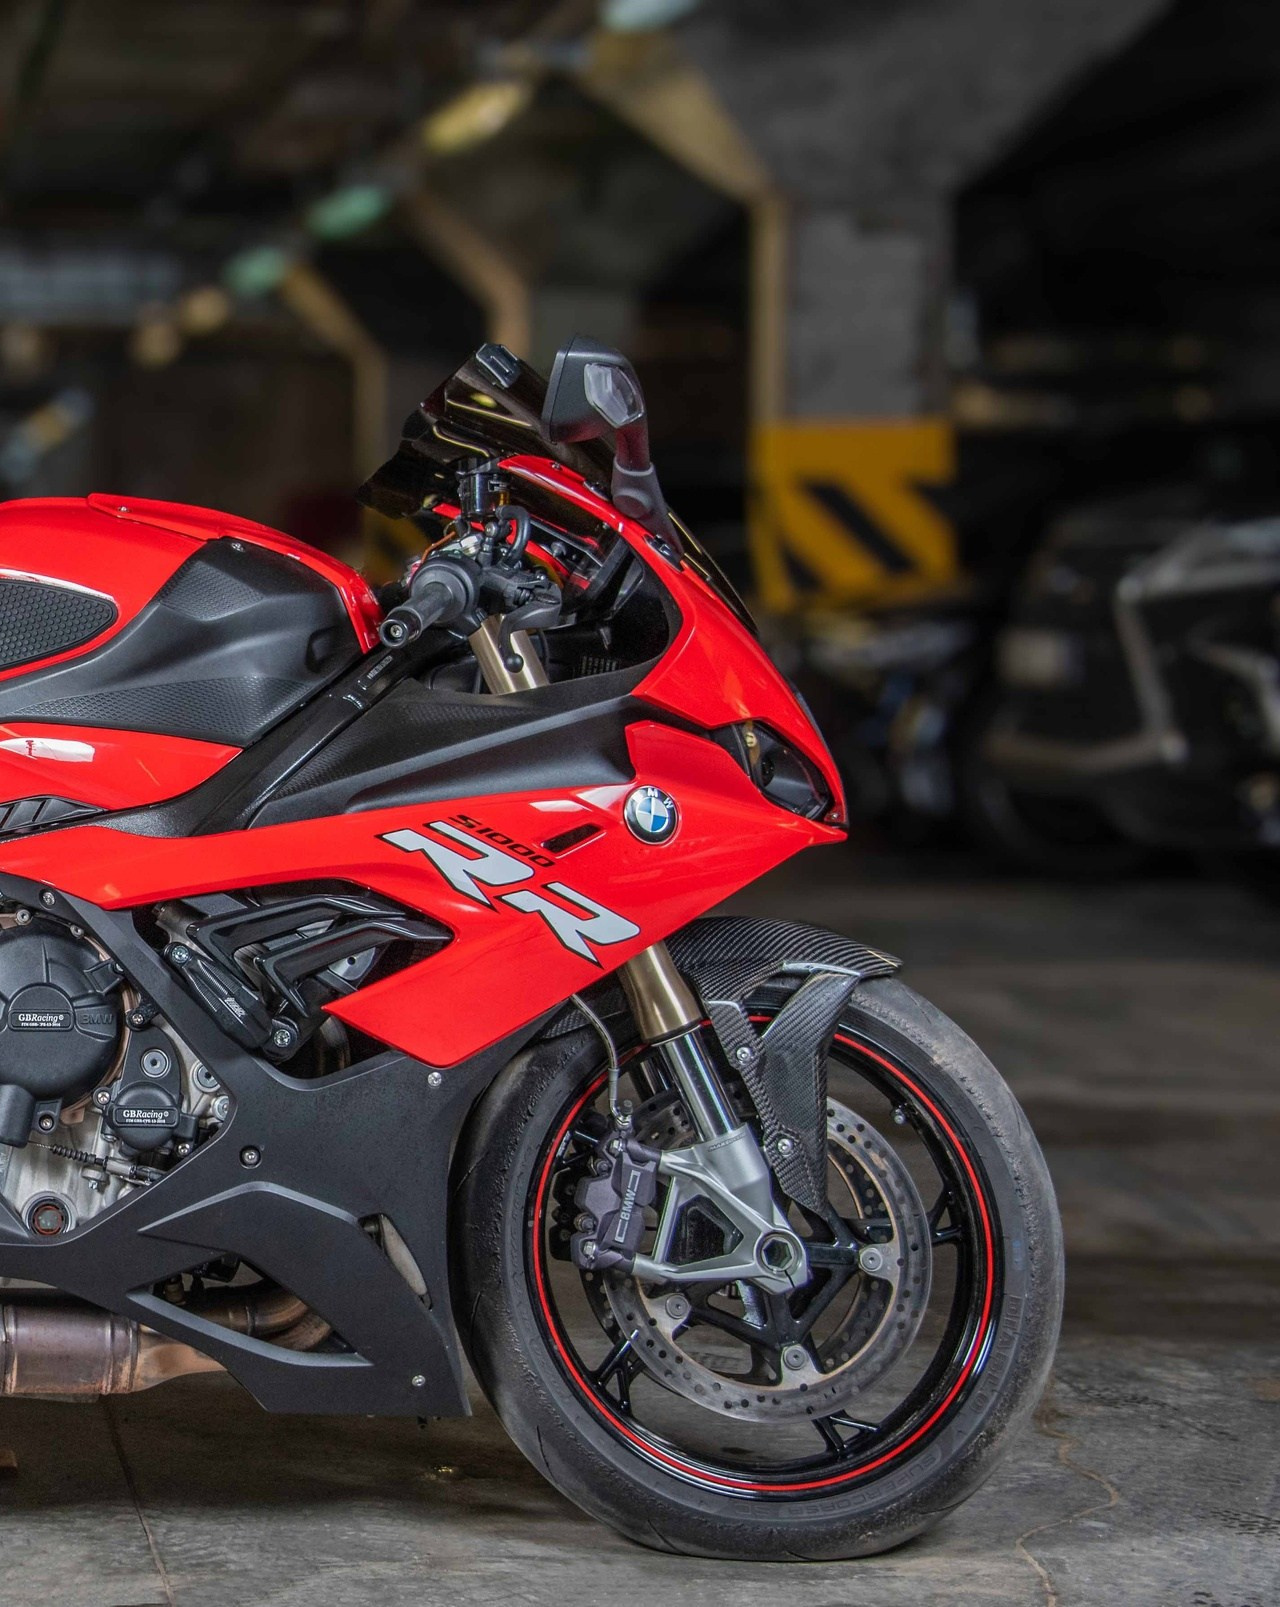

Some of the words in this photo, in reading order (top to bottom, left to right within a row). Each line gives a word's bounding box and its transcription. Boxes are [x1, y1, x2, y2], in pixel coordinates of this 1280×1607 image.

[448, 814, 556, 868] S1000
[374, 820, 641, 970] RR
[80, 1012, 113, 1025] BMW
[620, 1188, 637, 1220] BMW
[788, 1450, 937, 1517] SUPERCORSA
